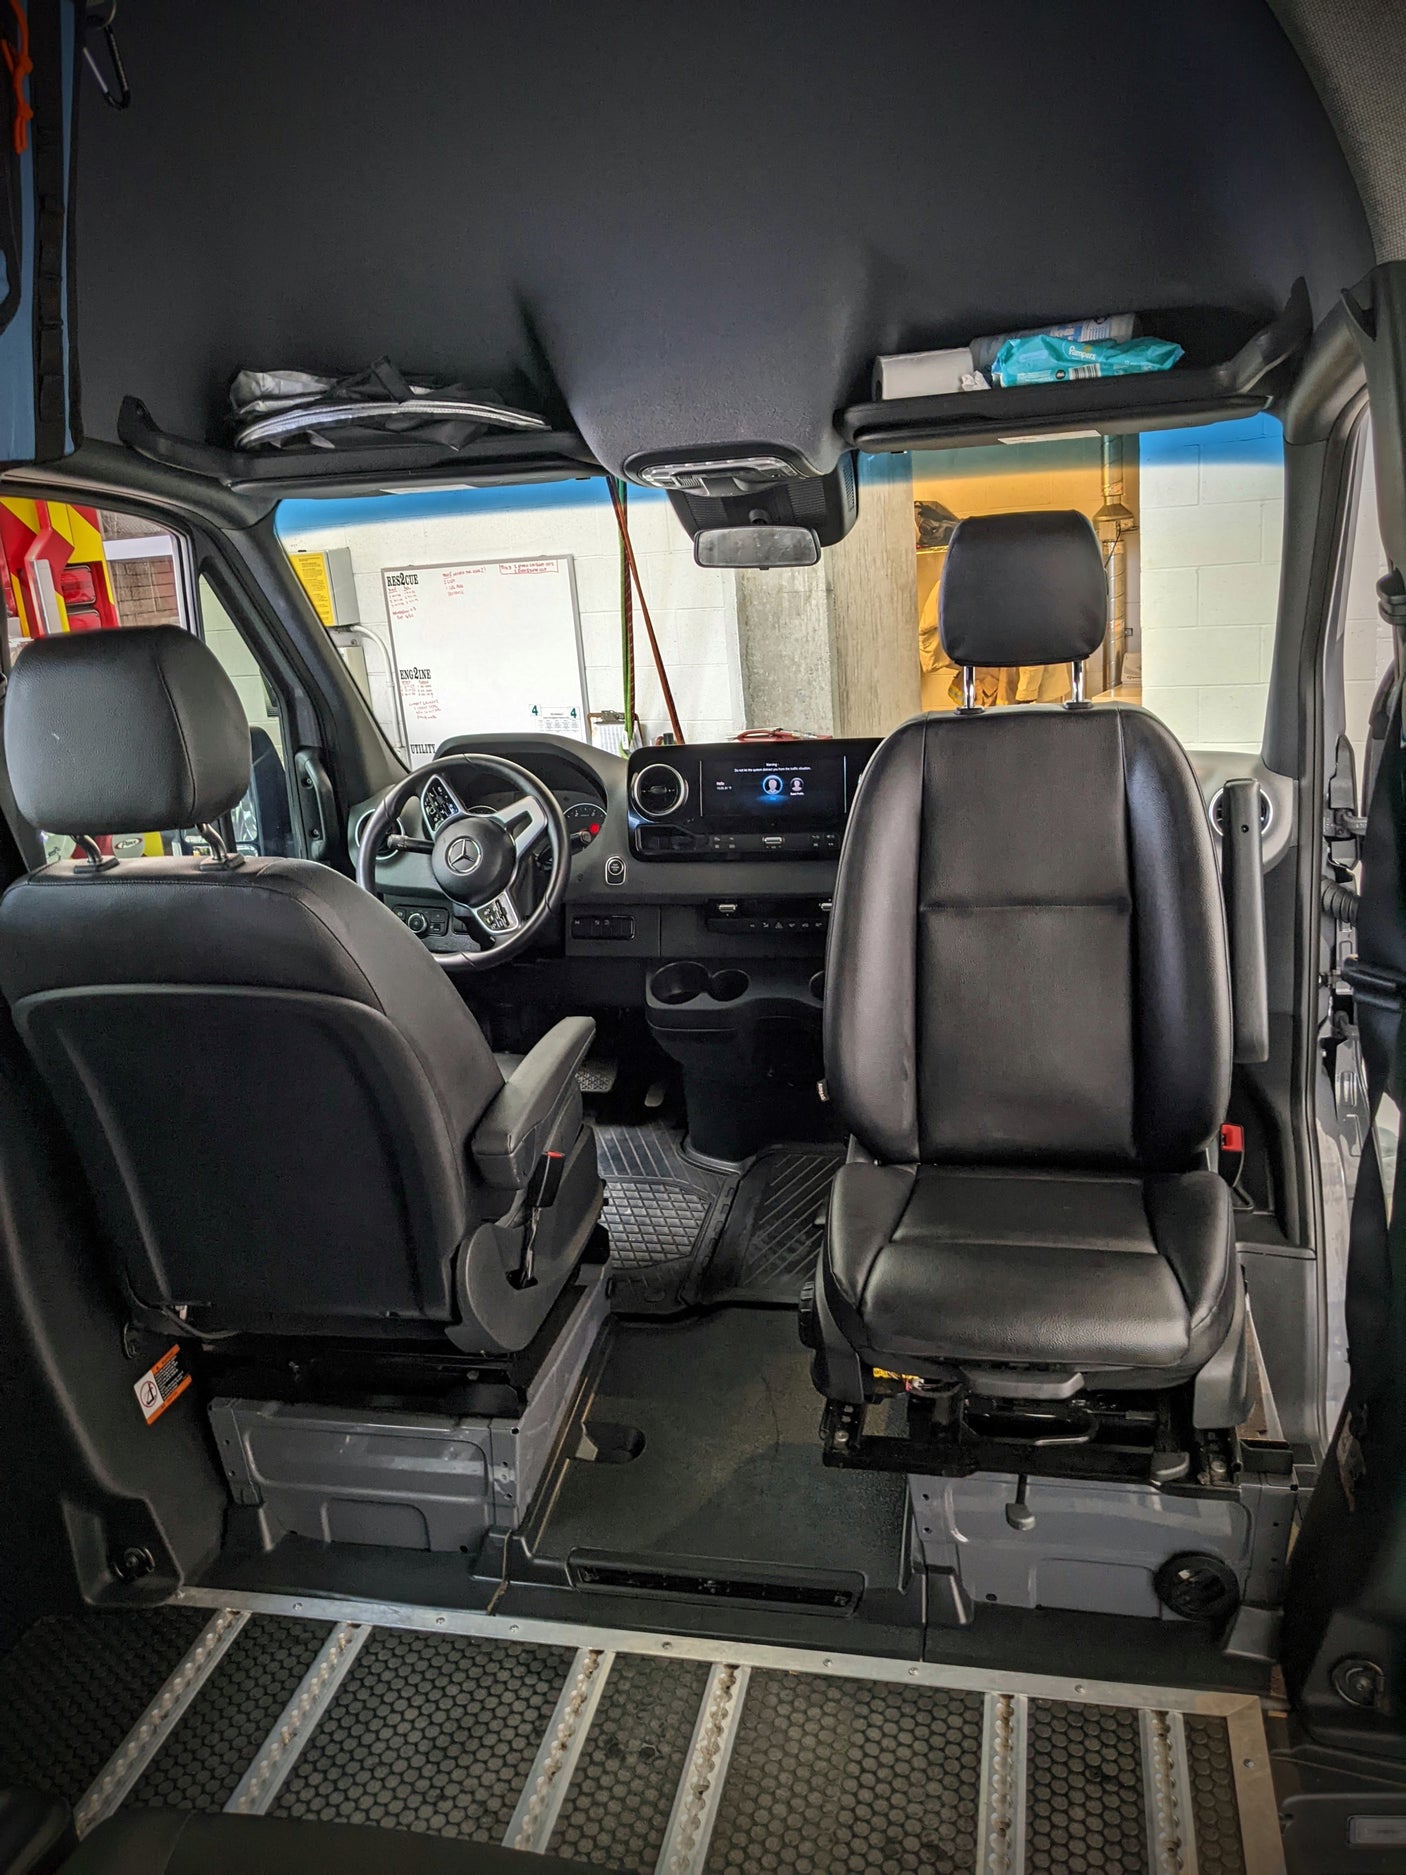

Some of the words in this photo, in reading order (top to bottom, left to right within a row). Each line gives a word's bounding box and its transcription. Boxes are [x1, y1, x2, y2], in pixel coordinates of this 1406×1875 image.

[1069, 345, 1097, 360] Pampers
[531, 705, 539, 716] 4
[570, 707, 577, 719] 4
[410, 744, 436, 754] UTILITY
